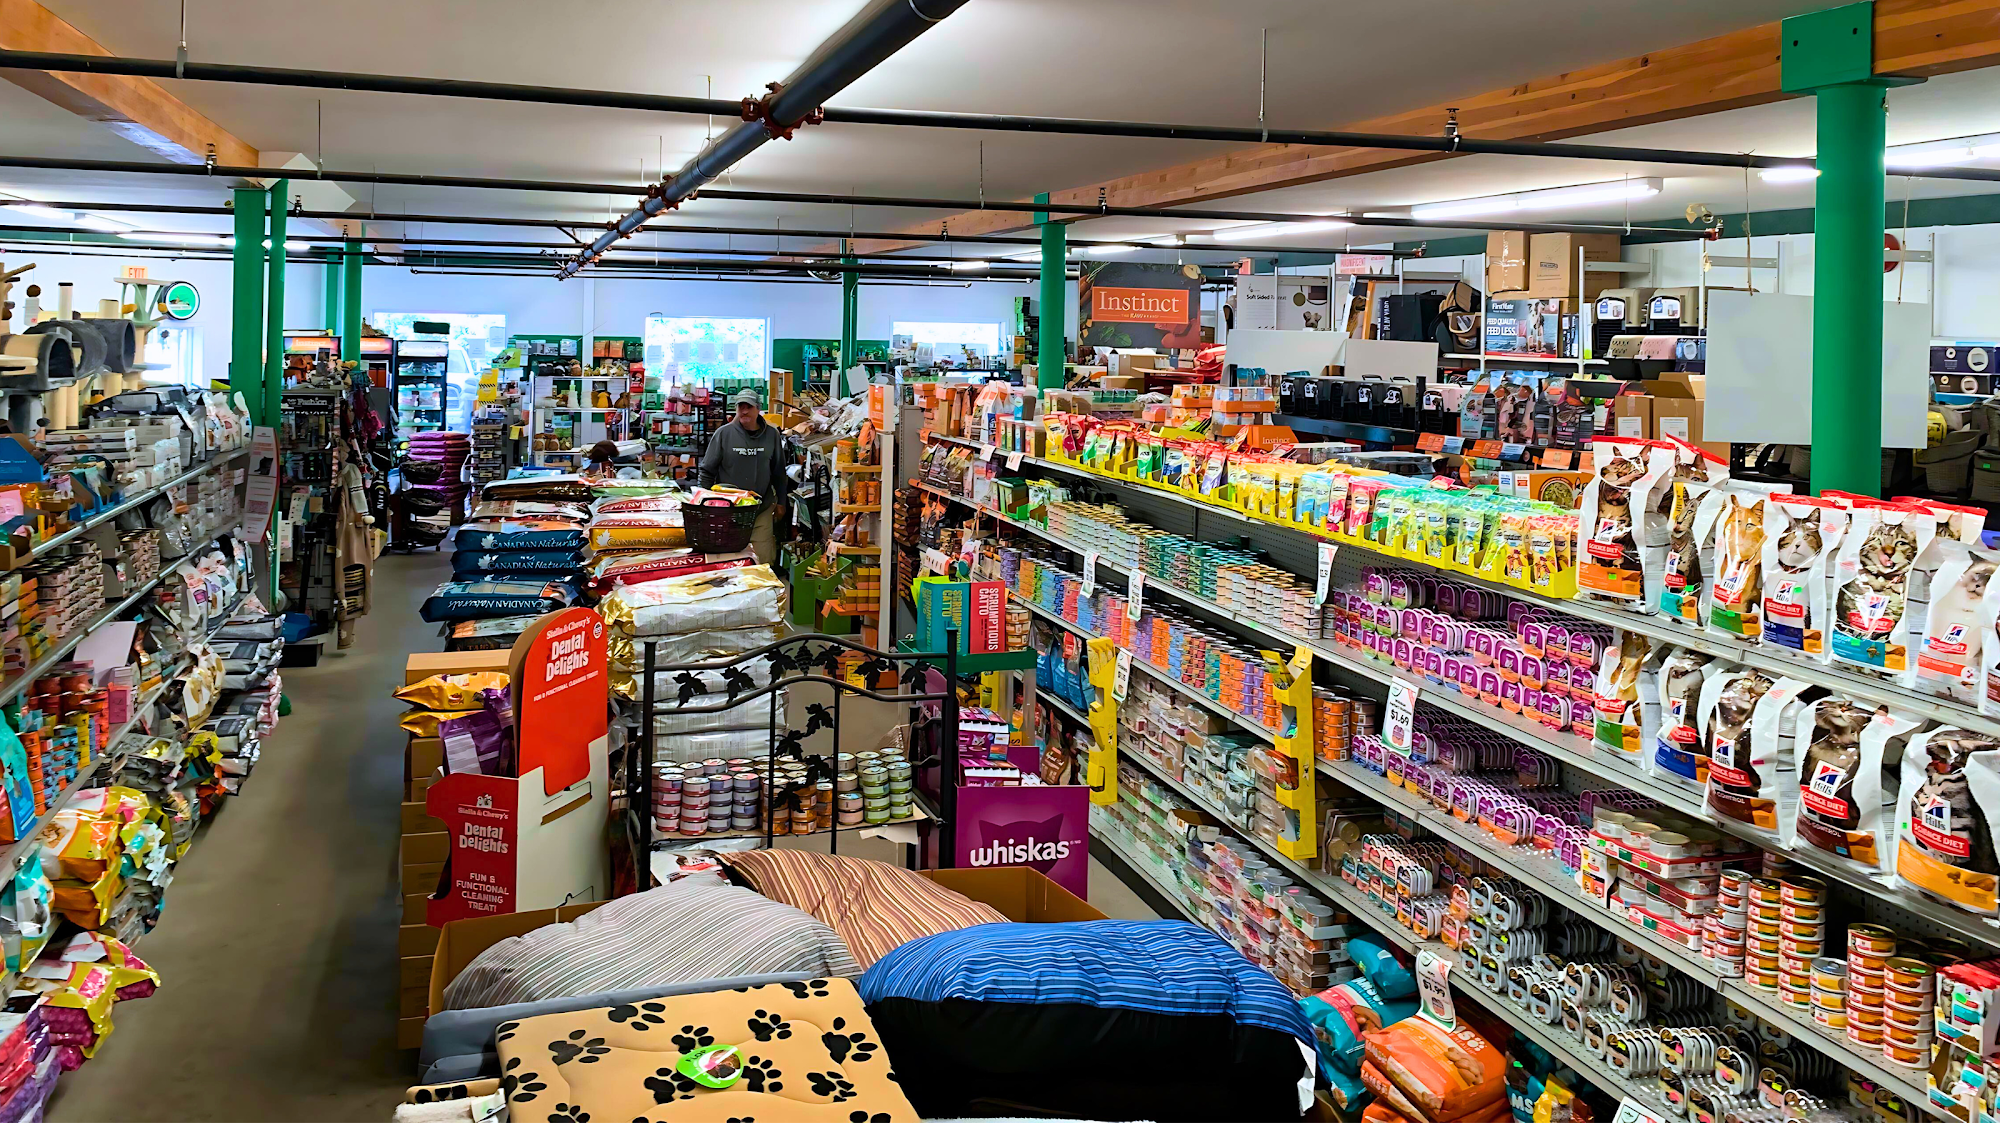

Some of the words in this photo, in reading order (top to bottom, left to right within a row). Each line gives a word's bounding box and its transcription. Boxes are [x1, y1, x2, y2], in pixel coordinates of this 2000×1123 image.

[1098, 291, 1180, 312] Instinct
[1486, 326, 1500, 335] FEED
[490, 539, 537, 548] CANADIAN
[487, 561, 534, 570] CANADIAN
[643, 557, 703, 570] CANADIAN
[448, 599, 495, 610] Naturals
[495, 599, 545, 608] CANADIAN
[942, 590, 953, 617] CATTO
[979, 588, 989, 616] CATTO
[568, 616, 591, 632] Chewy's
[988, 588, 999, 651] SCRUMPTIOUS
[551, 631, 585, 660] Dental
[546, 650, 590, 682] Delights
[1390, 708, 1410, 726] $1.69
[1813, 781, 1833, 796] Hill's
[1826, 800, 1846, 812] DIET
[482, 810, 509, 820] Chewy's
[1925, 815, 1947, 831] Hill's
[464, 822, 504, 840] Dental
[1913, 822, 1942, 843] SCIENCE
[1942, 836, 1965, 849] DIET
[459, 835, 509, 854] Delights
[970, 837, 1070, 867] whiskas
[469, 872, 487, 882] FUN
[489, 875, 496, 883] &
[456, 880, 510, 895] FUNCTIONAL
[461, 891, 504, 904] CLEANING
[468, 901, 497, 912] TREAT!
[1422, 979, 1446, 998] $1.99
[1511, 1092, 1534, 1115] MS
